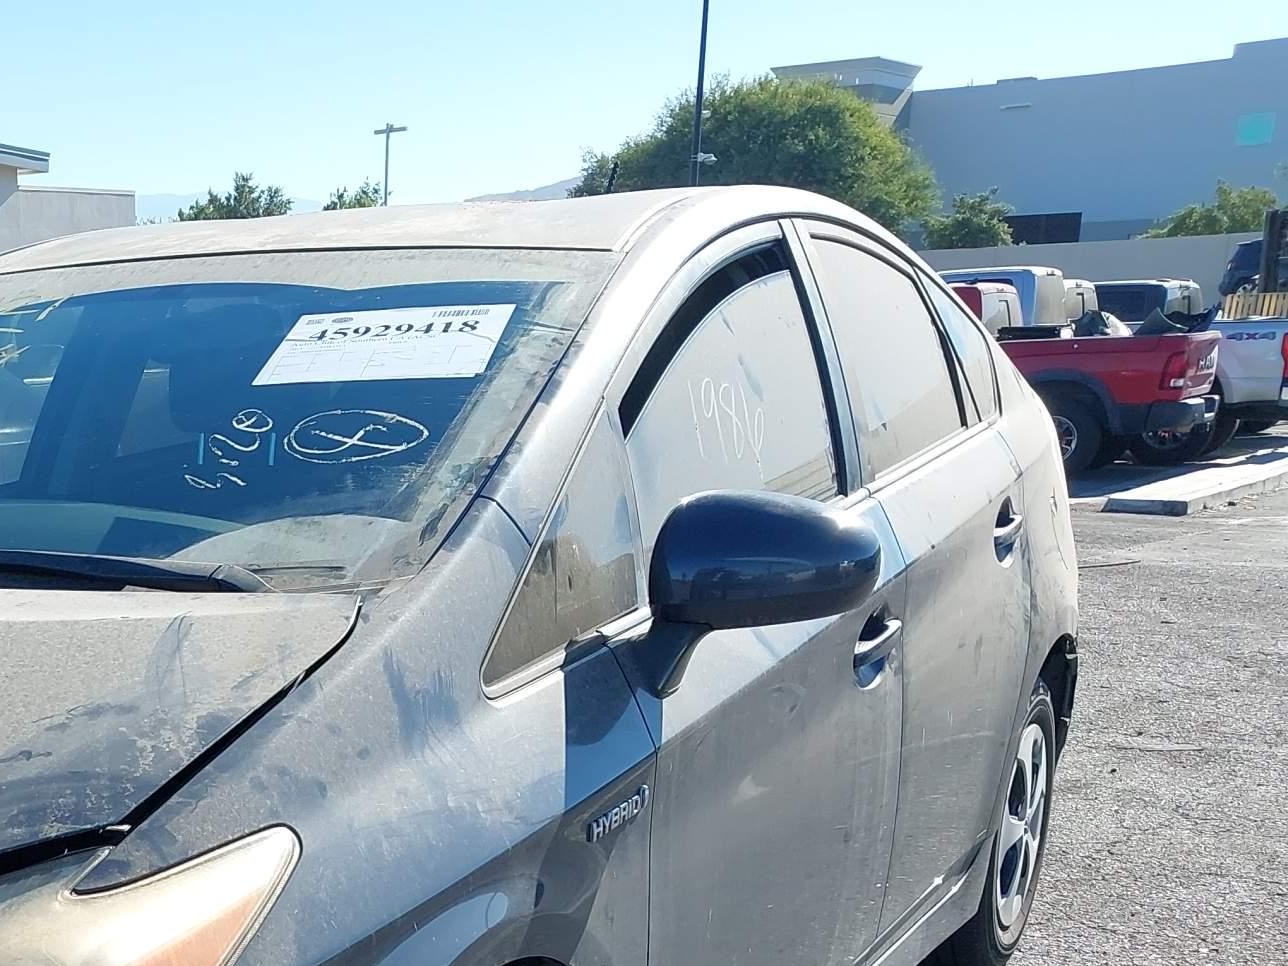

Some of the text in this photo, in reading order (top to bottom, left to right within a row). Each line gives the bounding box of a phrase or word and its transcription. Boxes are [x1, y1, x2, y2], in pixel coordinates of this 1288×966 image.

[309, 319, 481, 341] 45929418
[686, 376, 767, 482] 1986
[591, 795, 641, 843] HYBRID
